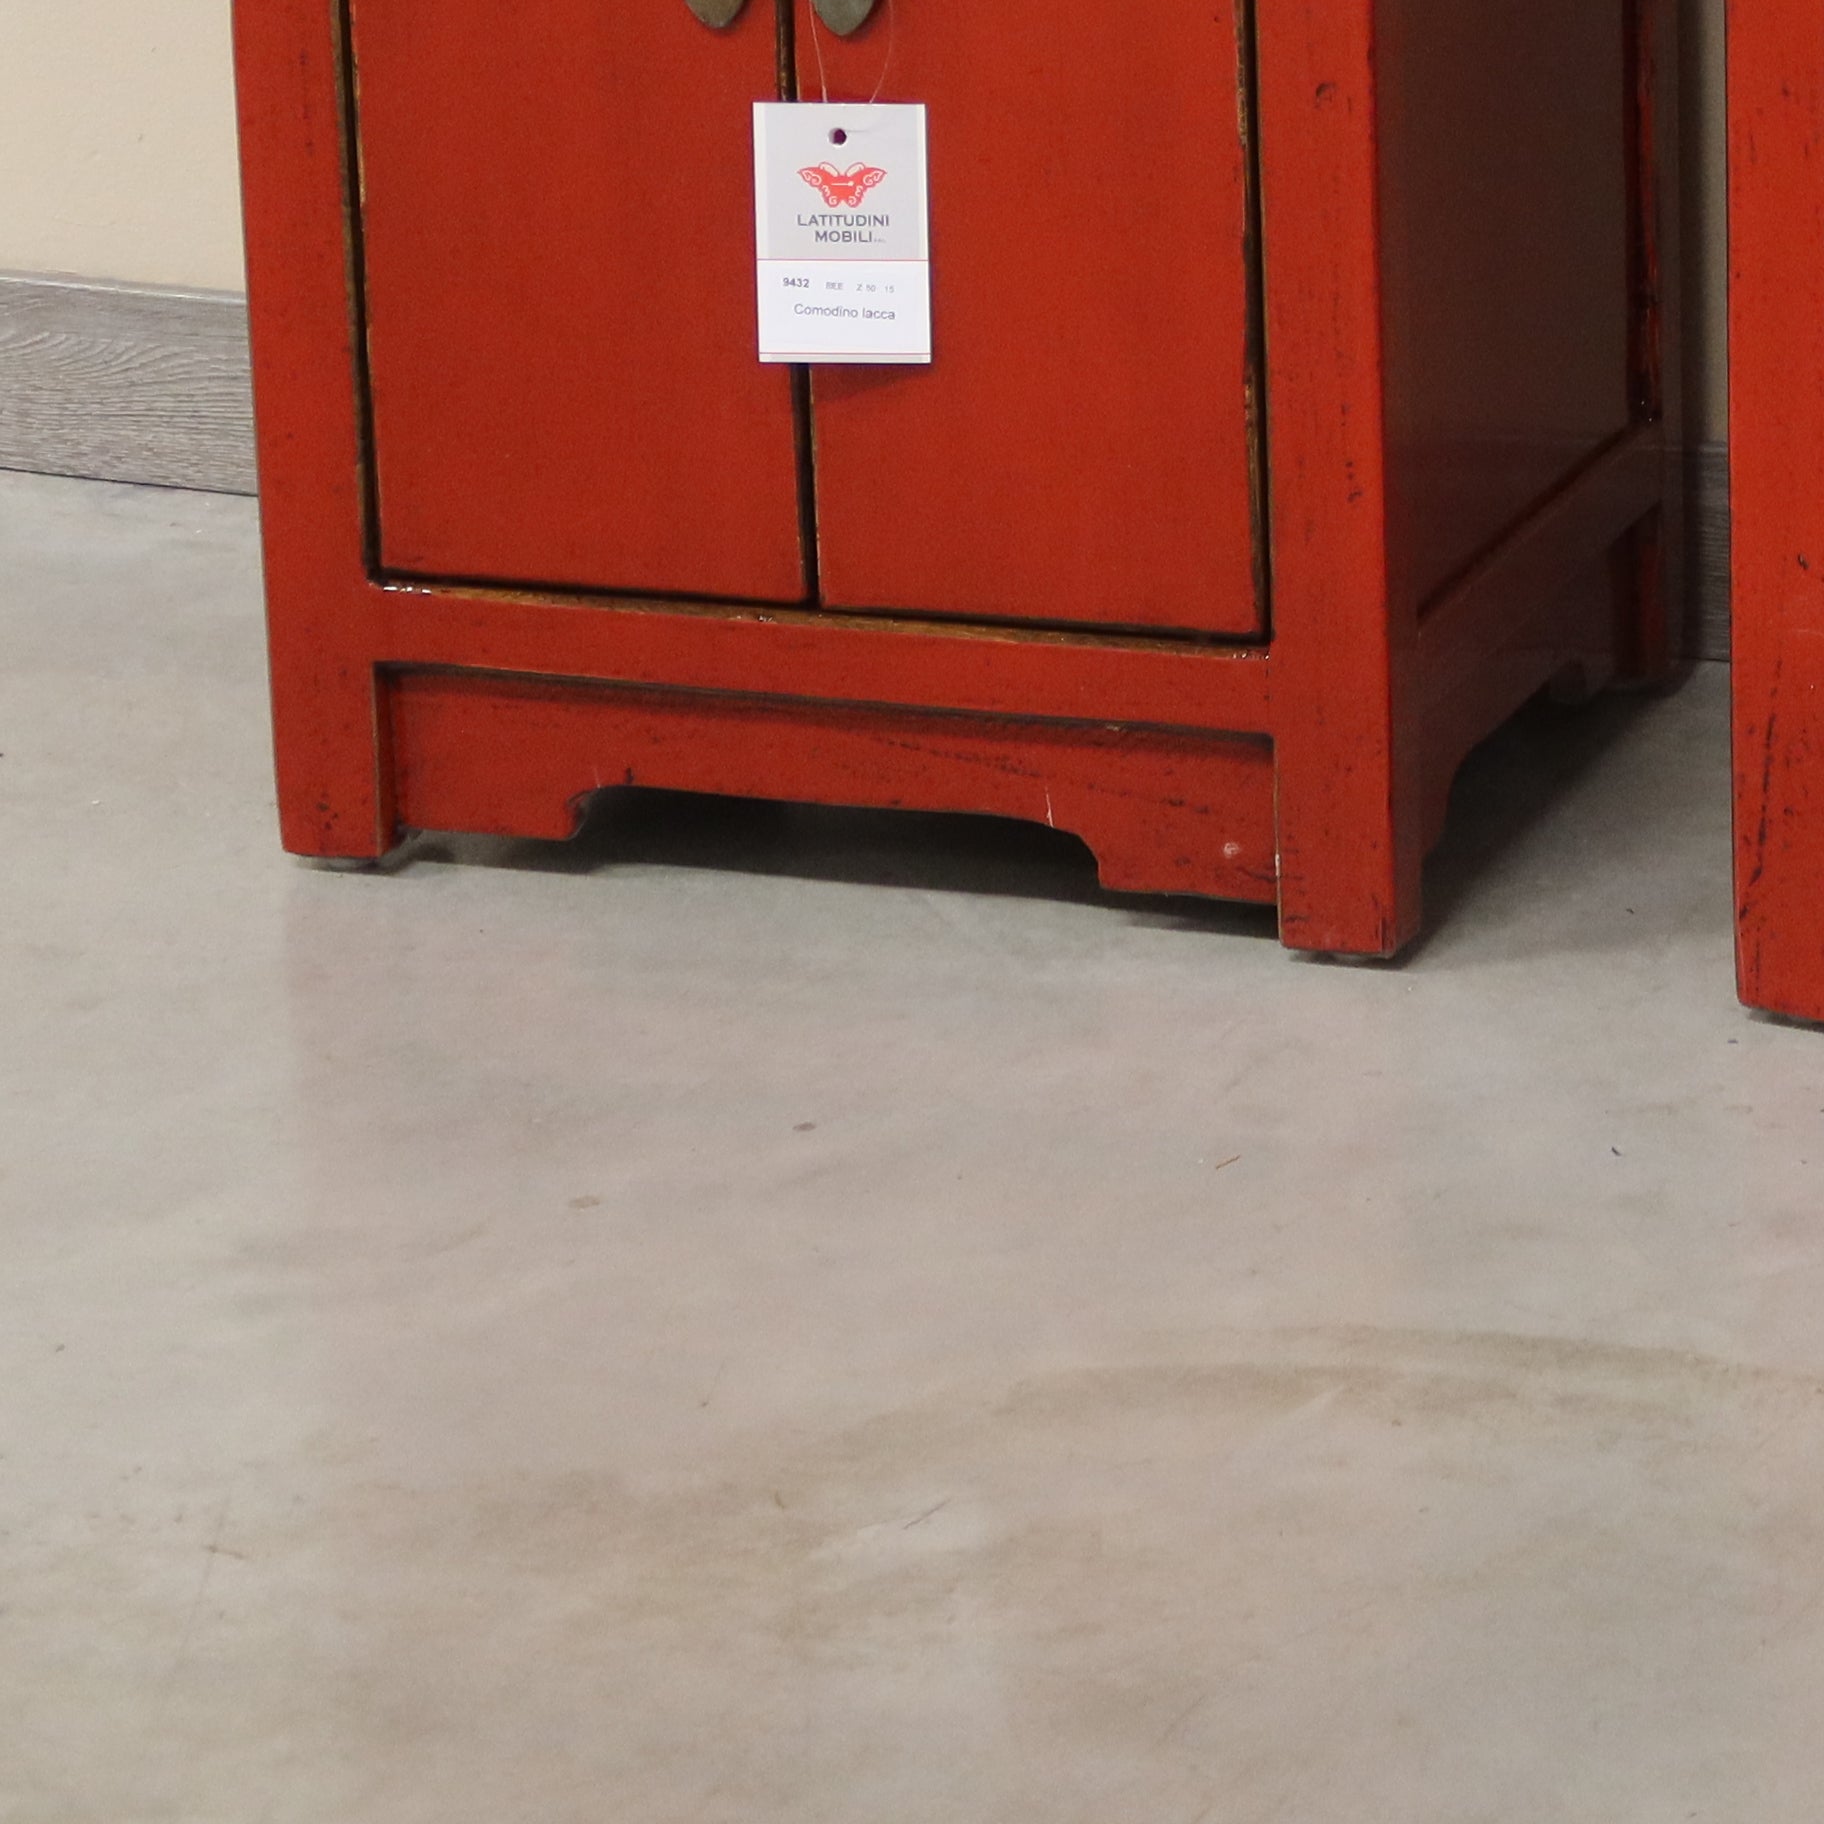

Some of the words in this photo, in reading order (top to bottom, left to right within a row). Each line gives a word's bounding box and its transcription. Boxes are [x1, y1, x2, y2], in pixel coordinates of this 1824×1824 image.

[797, 214, 889, 227] LATITUDINI
[815, 230, 873, 243] MOBILI
[783, 277, 810, 289] 9432
[794, 303, 859, 318] Comodino
[863, 307, 896, 320] lacca
